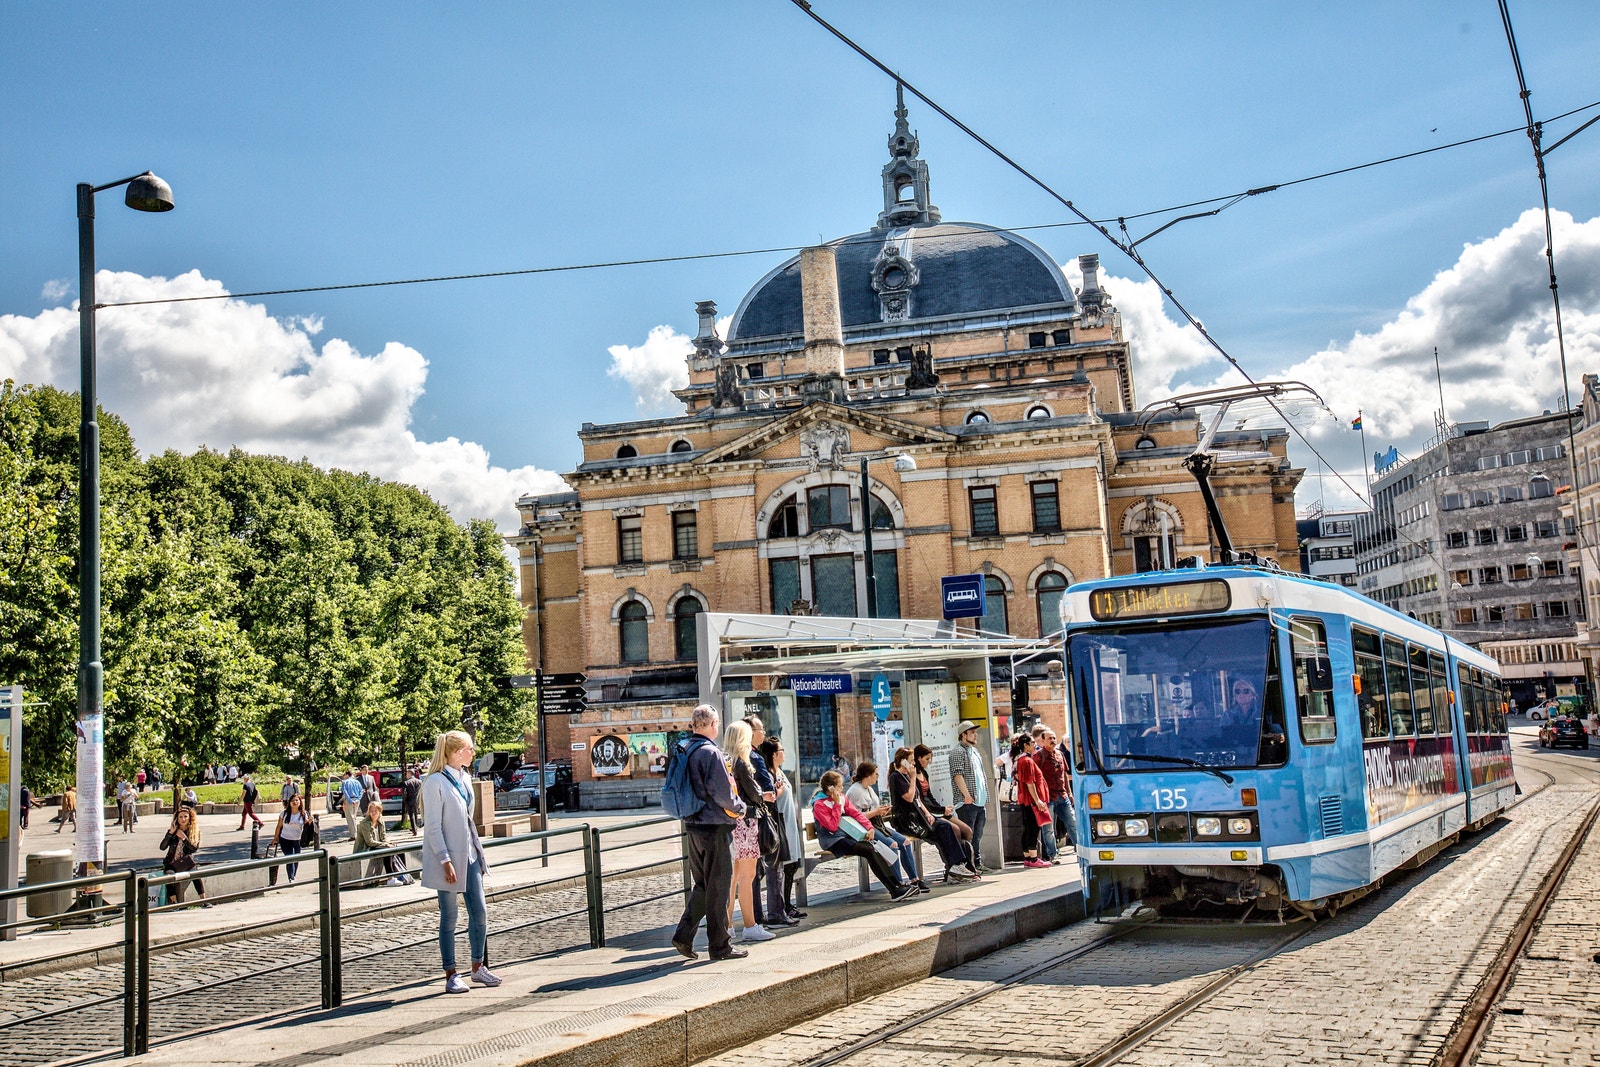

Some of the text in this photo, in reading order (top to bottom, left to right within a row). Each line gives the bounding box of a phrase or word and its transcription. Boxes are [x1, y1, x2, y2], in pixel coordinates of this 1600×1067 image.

[790, 677, 842, 691] Nationaltheatret
[878, 682, 885, 703] 5
[930, 698, 941, 709] OSLO
[931, 705, 947, 719] PRIDE
[1151, 788, 1188, 810] 135
